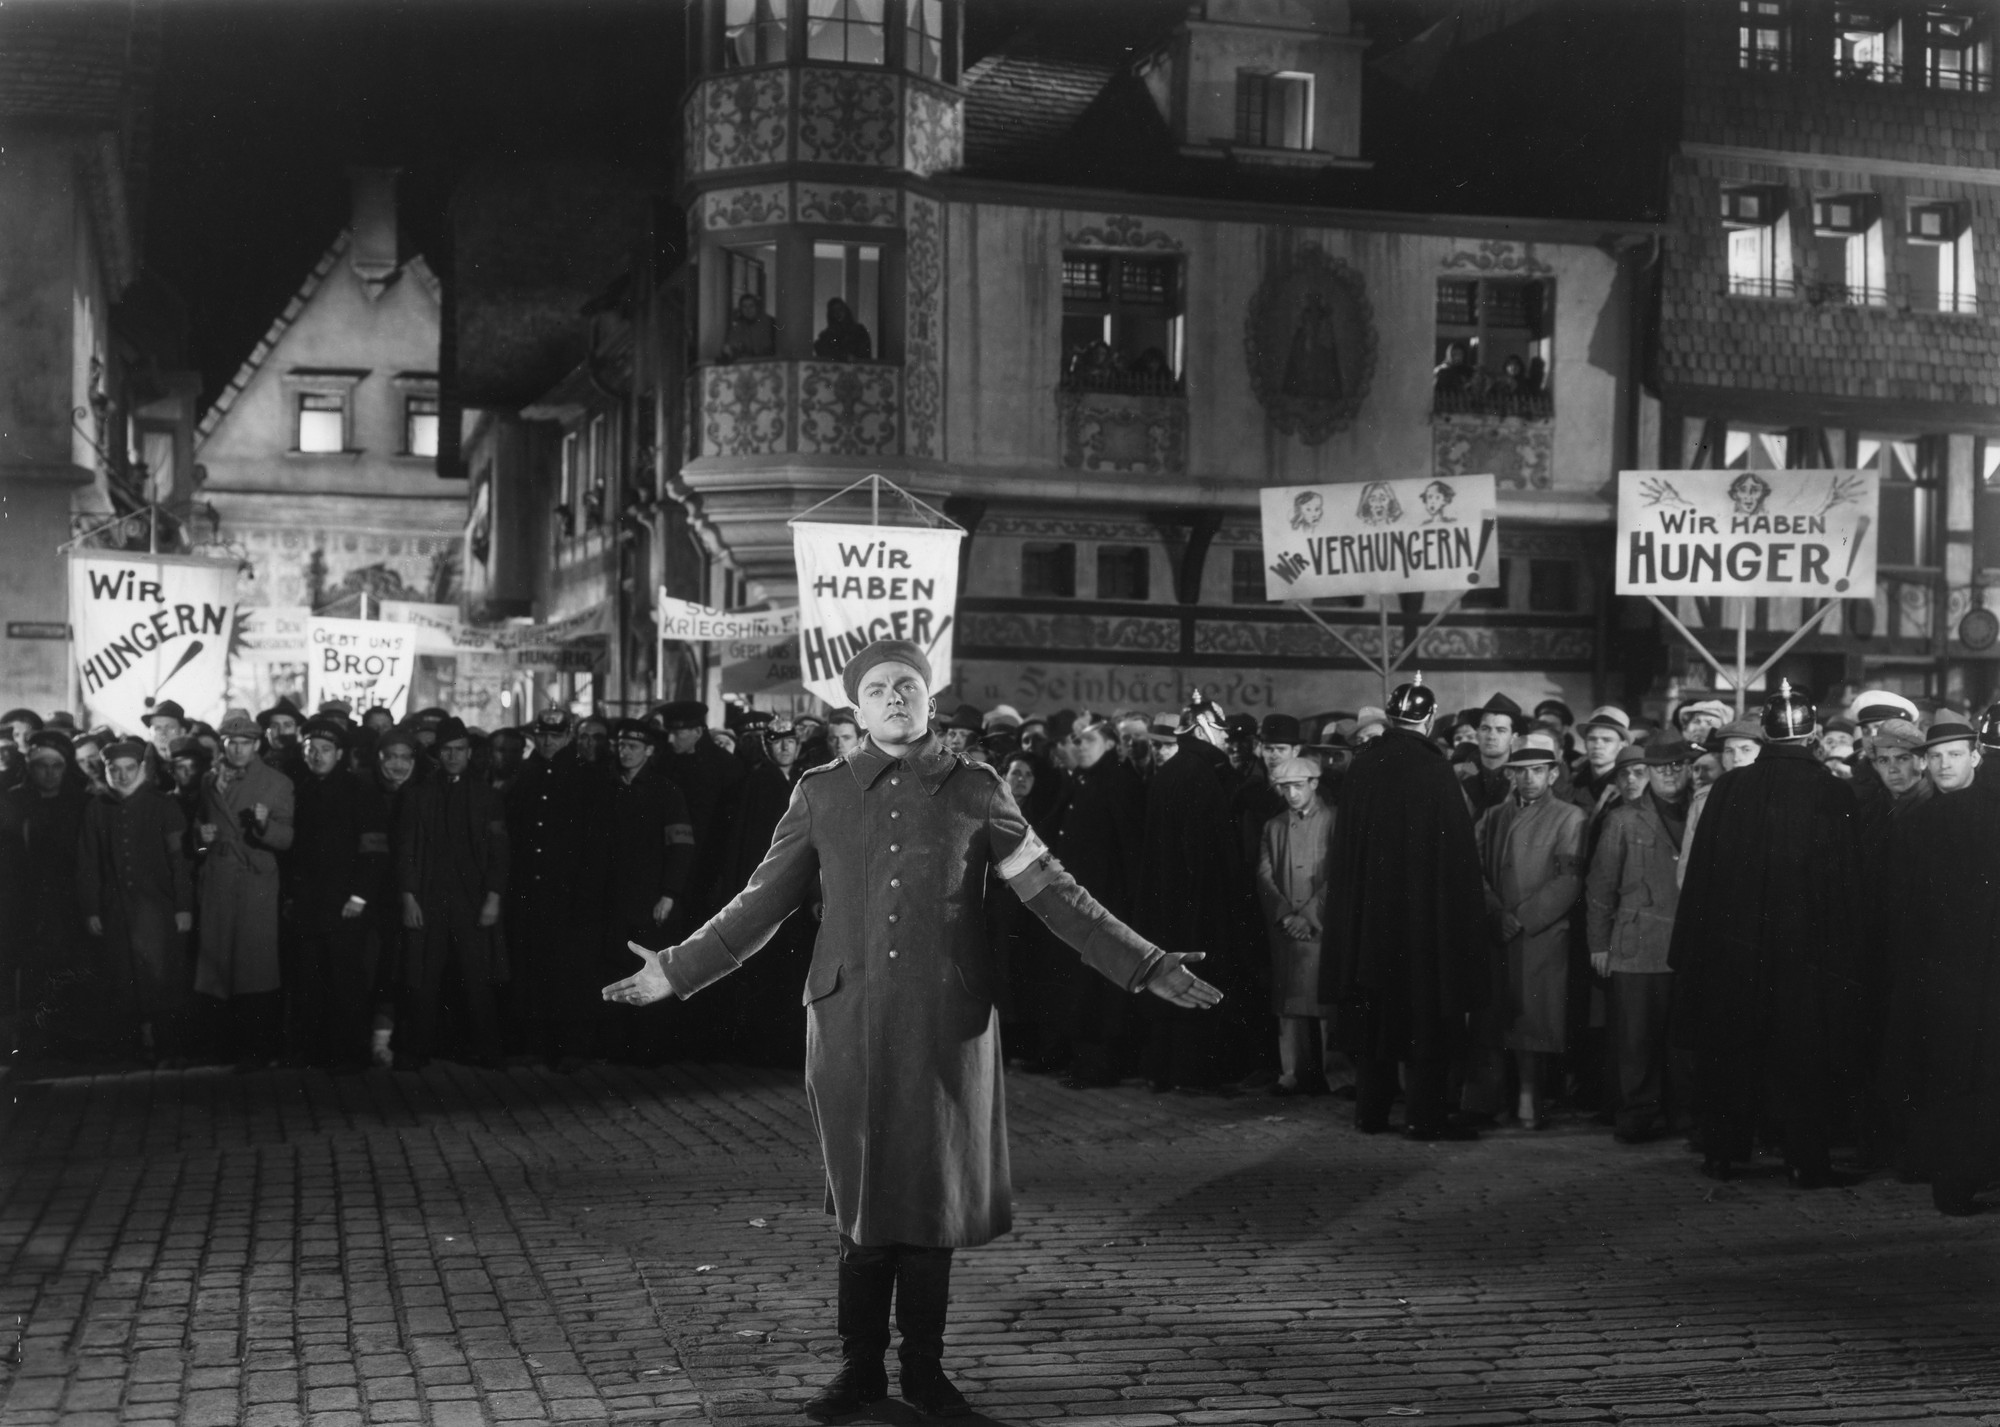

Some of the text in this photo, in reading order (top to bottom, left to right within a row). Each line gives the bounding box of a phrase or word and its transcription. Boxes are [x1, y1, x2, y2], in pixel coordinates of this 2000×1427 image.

[1731, 515, 1827, 535] HABEN
[1307, 517, 1496, 585] VERHUNGERN!
[1628, 515, 1871, 593] HUNGER!
[813, 575, 935, 600] HABEN
[324, 648, 400, 676] BROT
